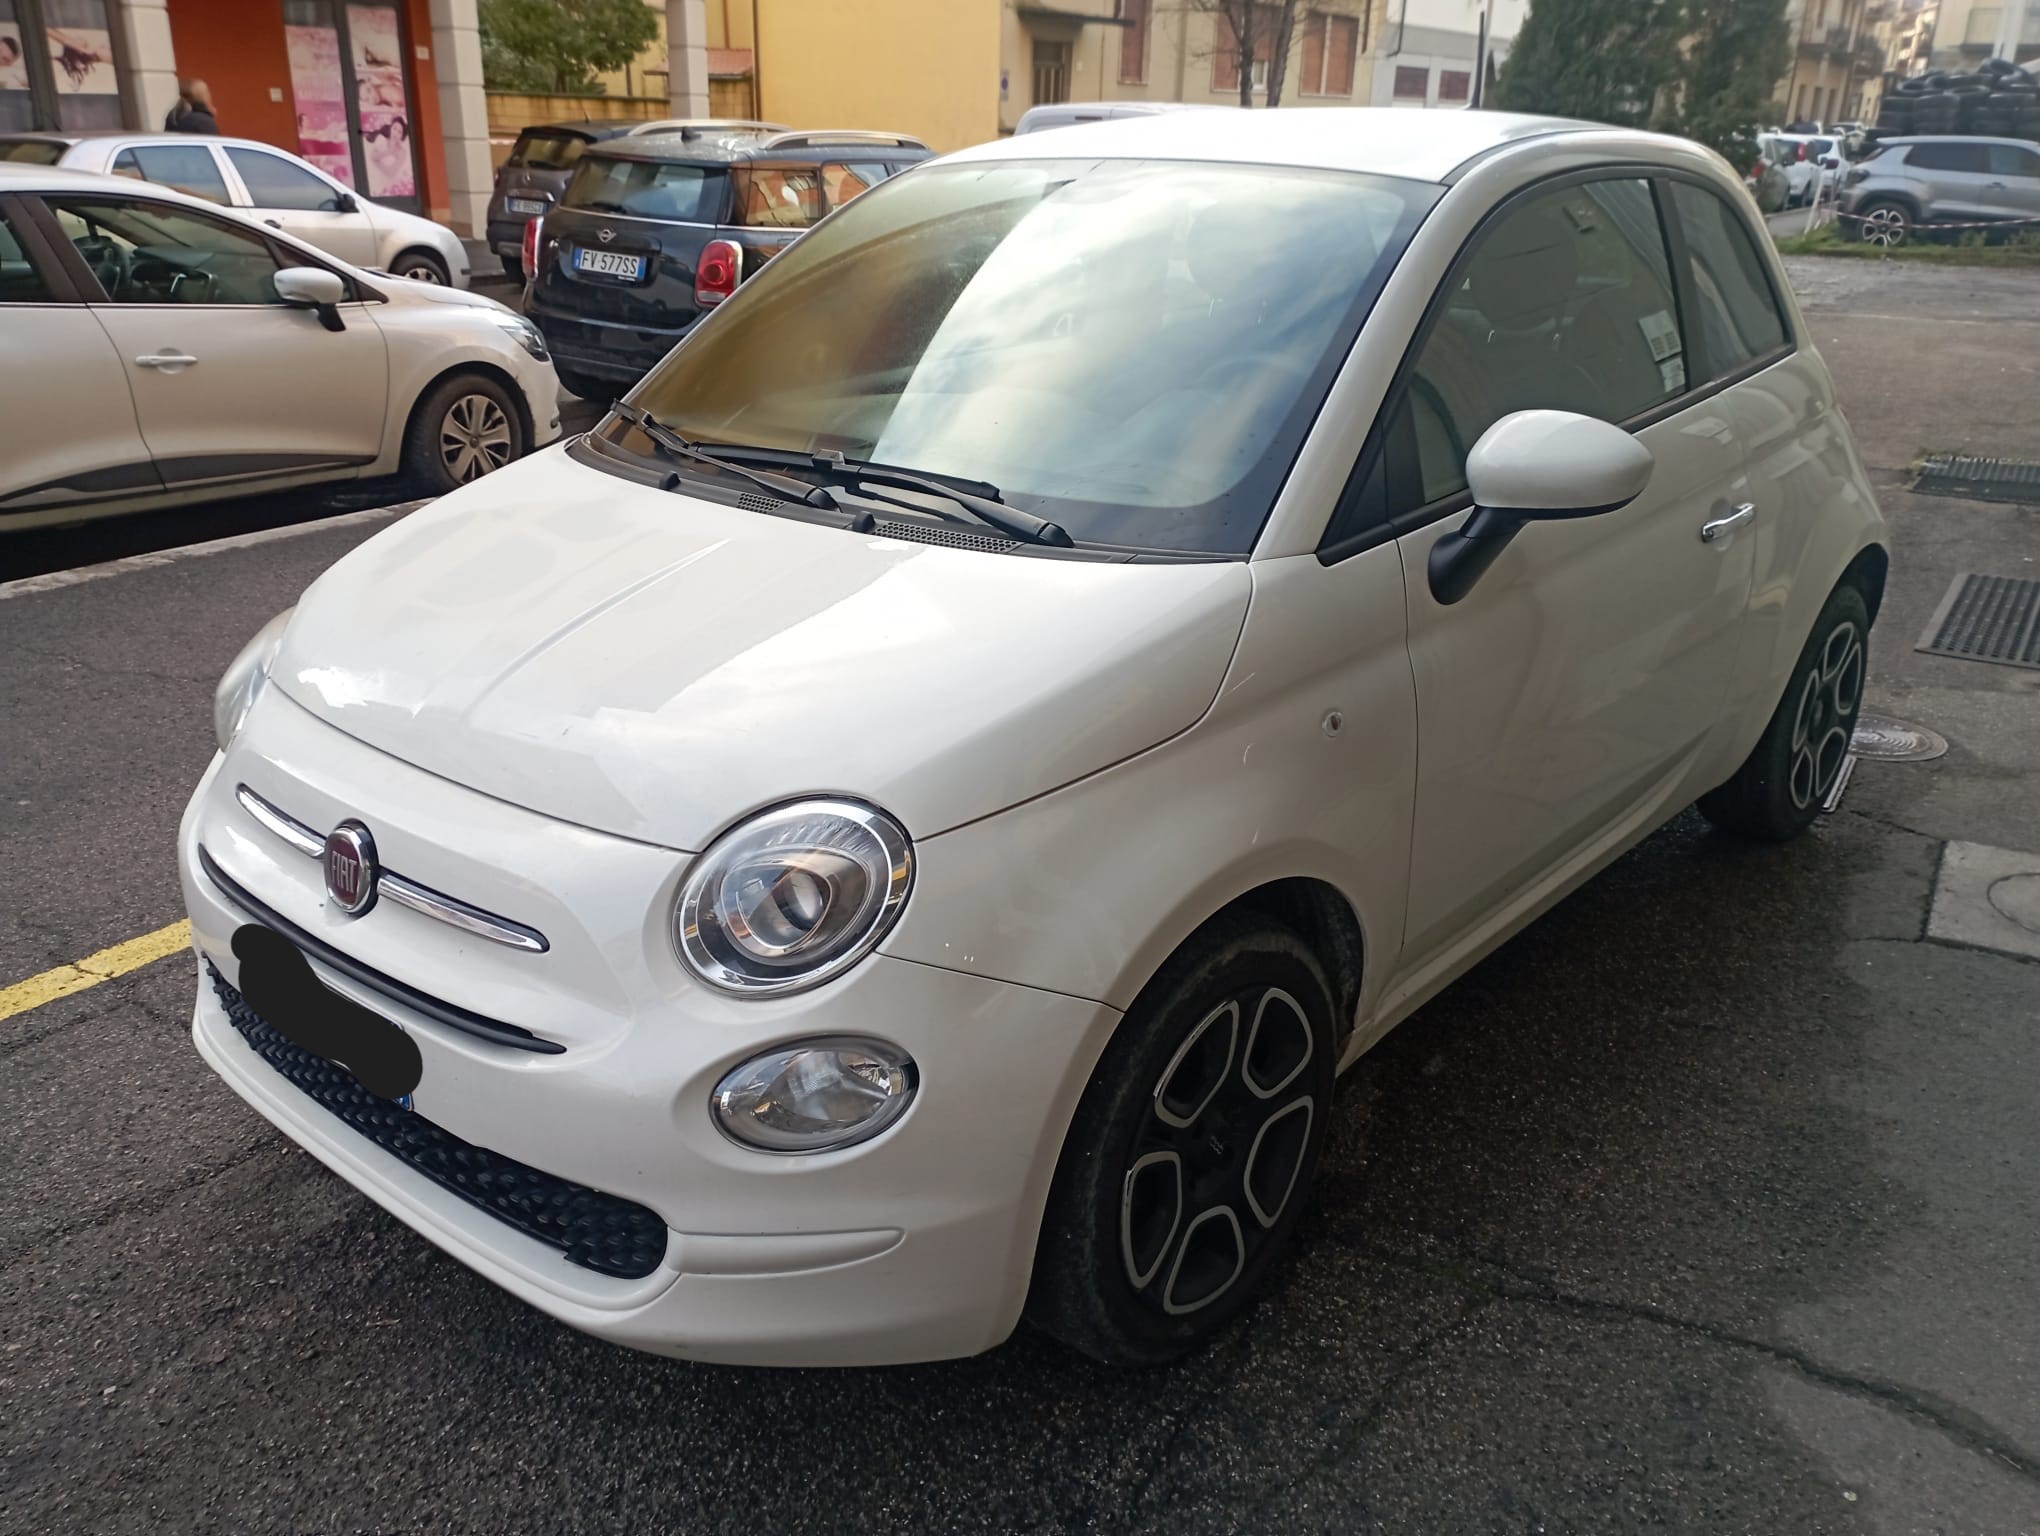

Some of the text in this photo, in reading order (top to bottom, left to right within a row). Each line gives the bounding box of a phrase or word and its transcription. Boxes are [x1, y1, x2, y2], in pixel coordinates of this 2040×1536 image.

[581, 251, 637, 274] FV 577SS
[331, 850, 358, 894] FIAT
